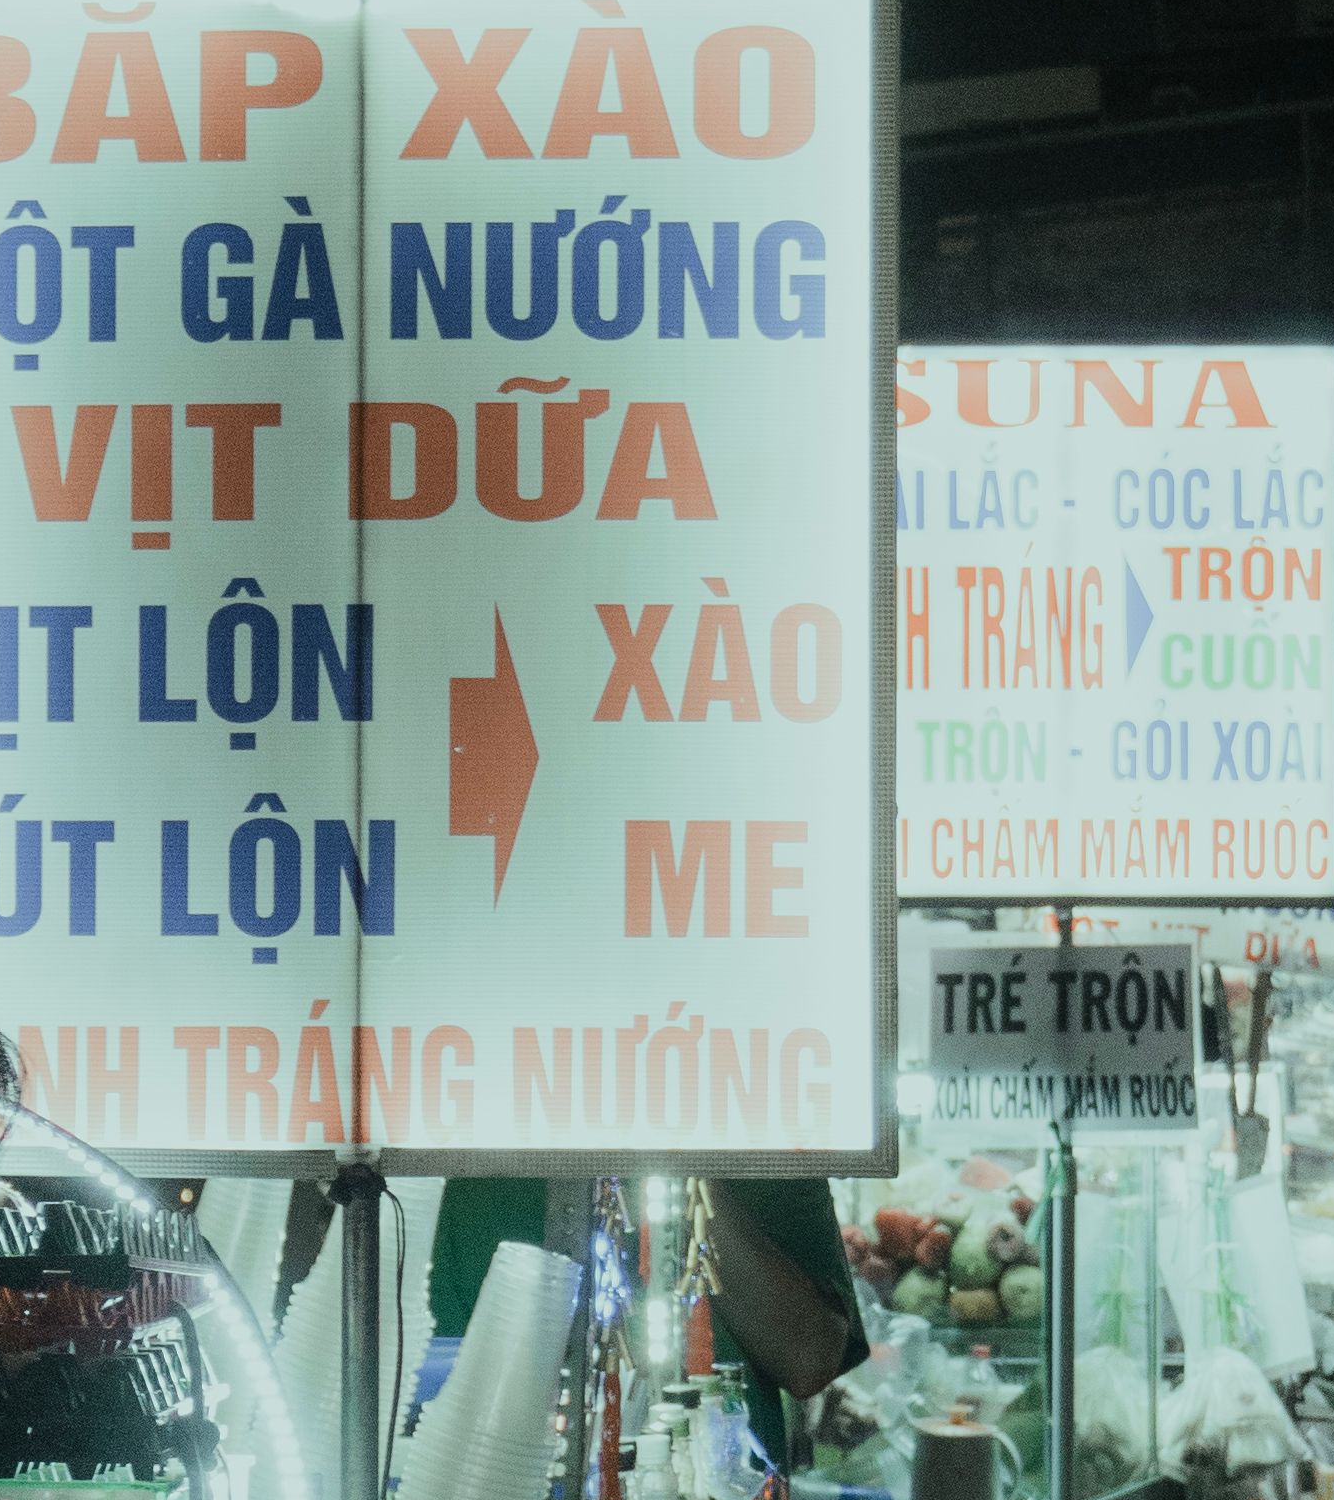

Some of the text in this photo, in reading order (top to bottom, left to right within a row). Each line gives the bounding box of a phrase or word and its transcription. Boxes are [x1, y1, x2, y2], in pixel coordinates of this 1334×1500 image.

[179, 195, 344, 343] GÀ
[389, 194, 827, 341] NƯỚNG
[11, 374, 719, 551] VỊT DỮA
[1114, 450, 1211, 531] CÓC
[1232, 442, 1325, 531] LẮC
[956, 541, 1104, 691] TRÁNG
[1161, 535, 1323, 613] TRỘN
[138, 577, 376, 752] LỘN
[592, 577, 844, 723] XÀO
[1160, 611, 1323, 691] CUỐN
[915, 706, 1049, 797] TRỘN
[1212, 706, 1323, 782] XOÀI
[159, 791, 397, 966] LỘN
[621, 819, 811, 939] ME
[1080, 795, 1191, 880] MẮM
[1211, 798, 1330, 881] RUỐC
[935, 951, 1187, 1047] TRÉ TRỘN
[173, 998, 475, 1147] TRÁNG
[512, 1000, 833, 1151] NƯỚNG
[1129, 1056, 1196, 1119] RUỐC
